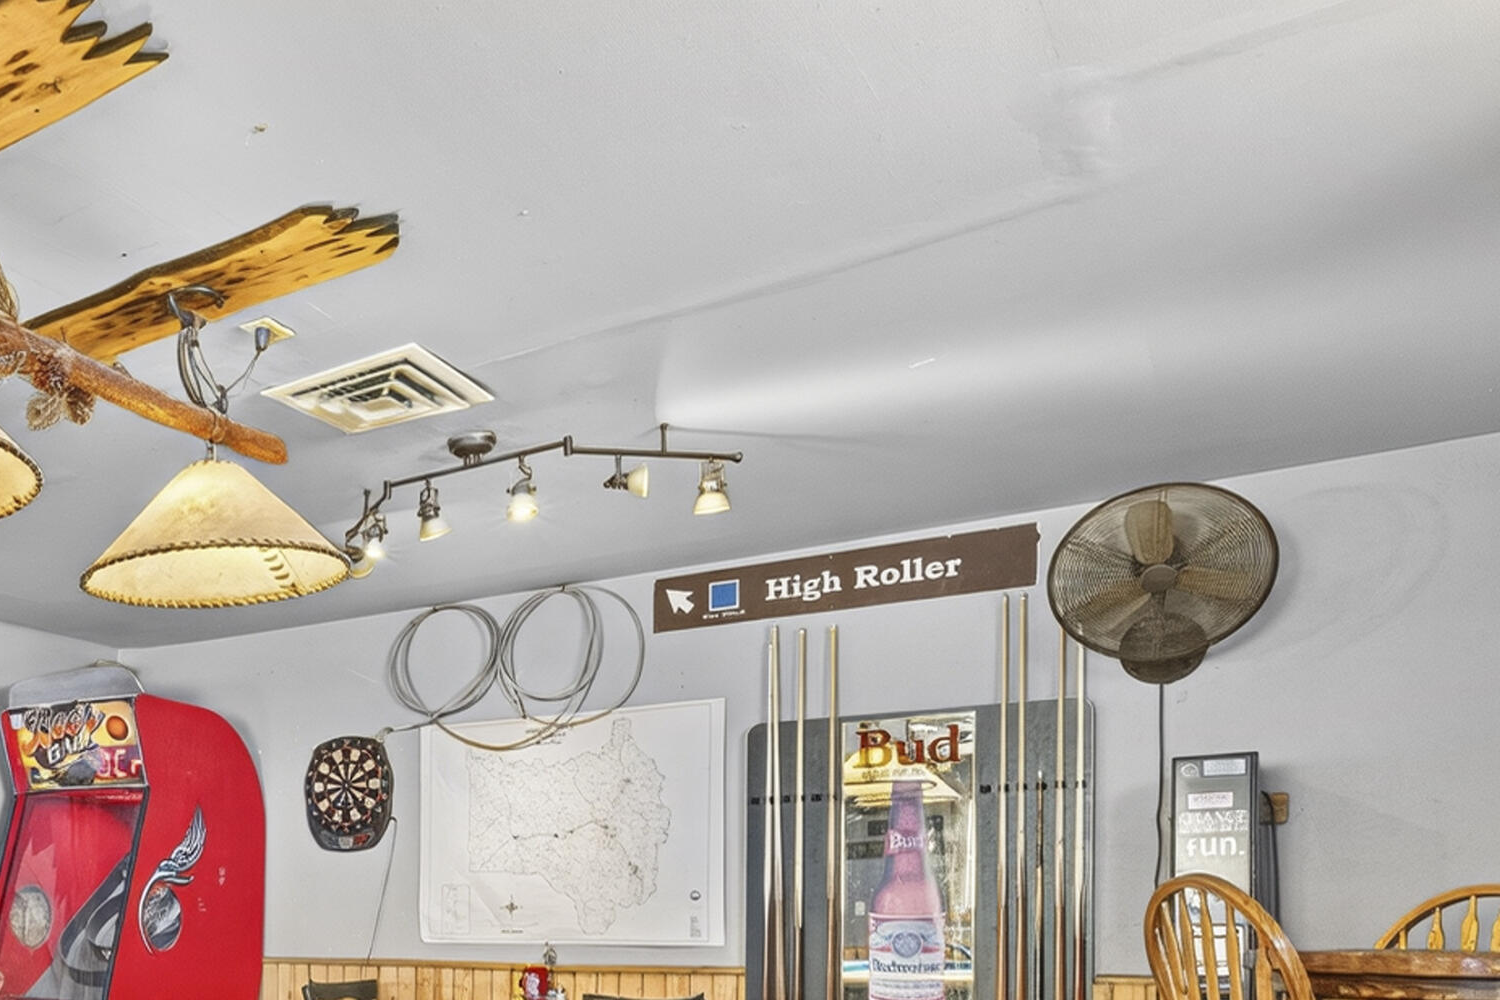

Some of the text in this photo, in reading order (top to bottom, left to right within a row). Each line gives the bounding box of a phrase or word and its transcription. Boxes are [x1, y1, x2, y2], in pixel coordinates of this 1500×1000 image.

[765, 557, 963, 603] High Roller
[853, 724, 962, 769] Bud
[1186, 836, 1245, 857] fun.
